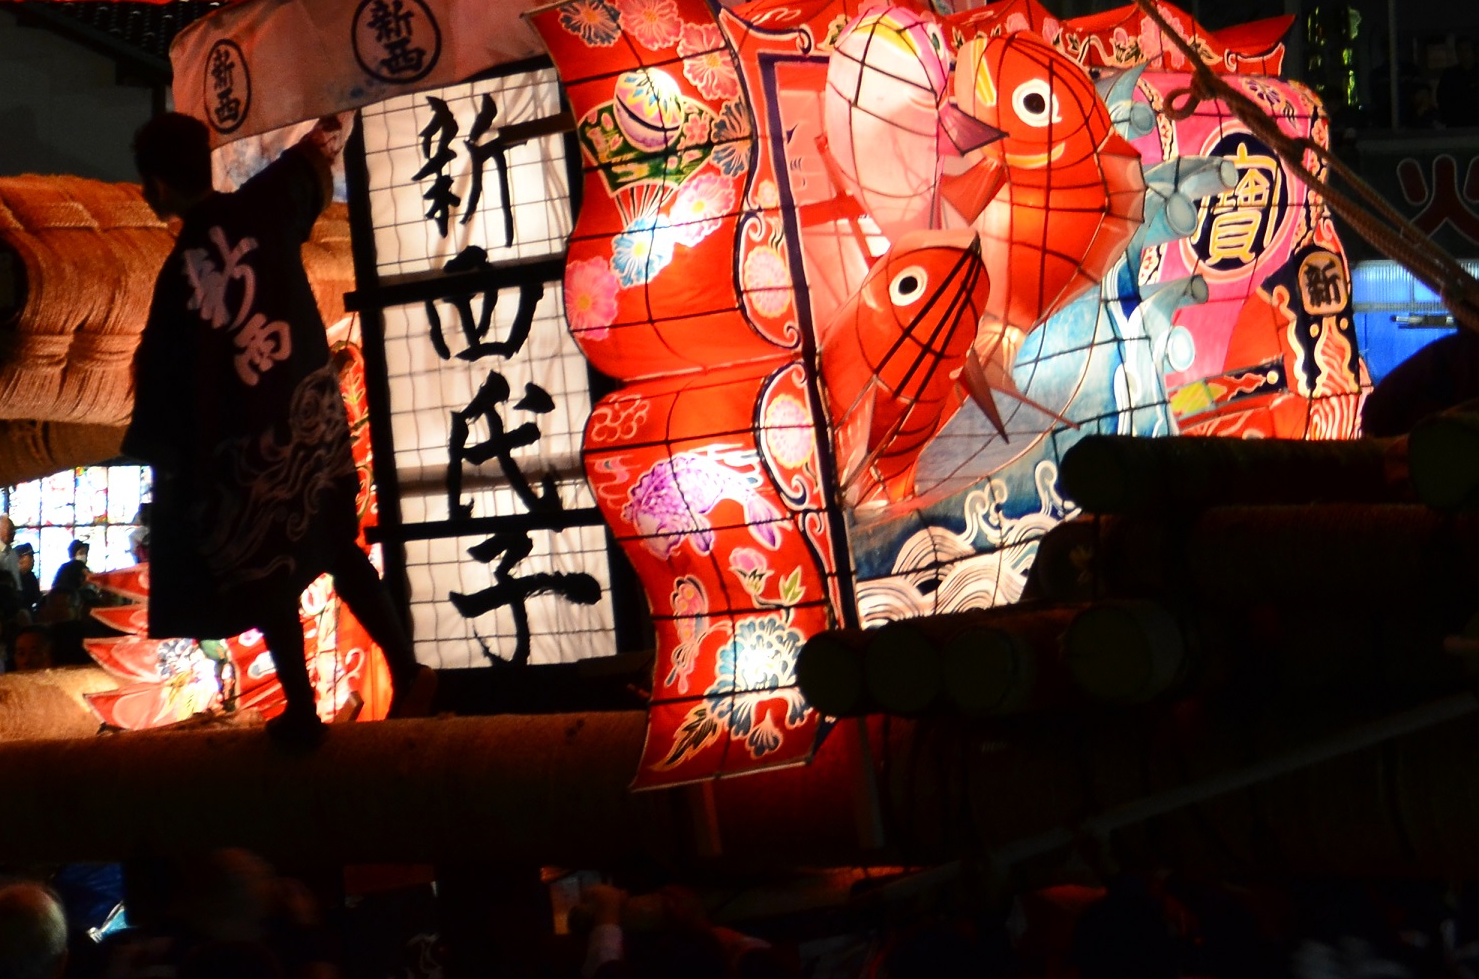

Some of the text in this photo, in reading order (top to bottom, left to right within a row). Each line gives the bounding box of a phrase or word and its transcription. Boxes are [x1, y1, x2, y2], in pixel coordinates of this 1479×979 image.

[211, 47, 241, 124] 新西
[411, 95, 602, 666] 新西氏子
